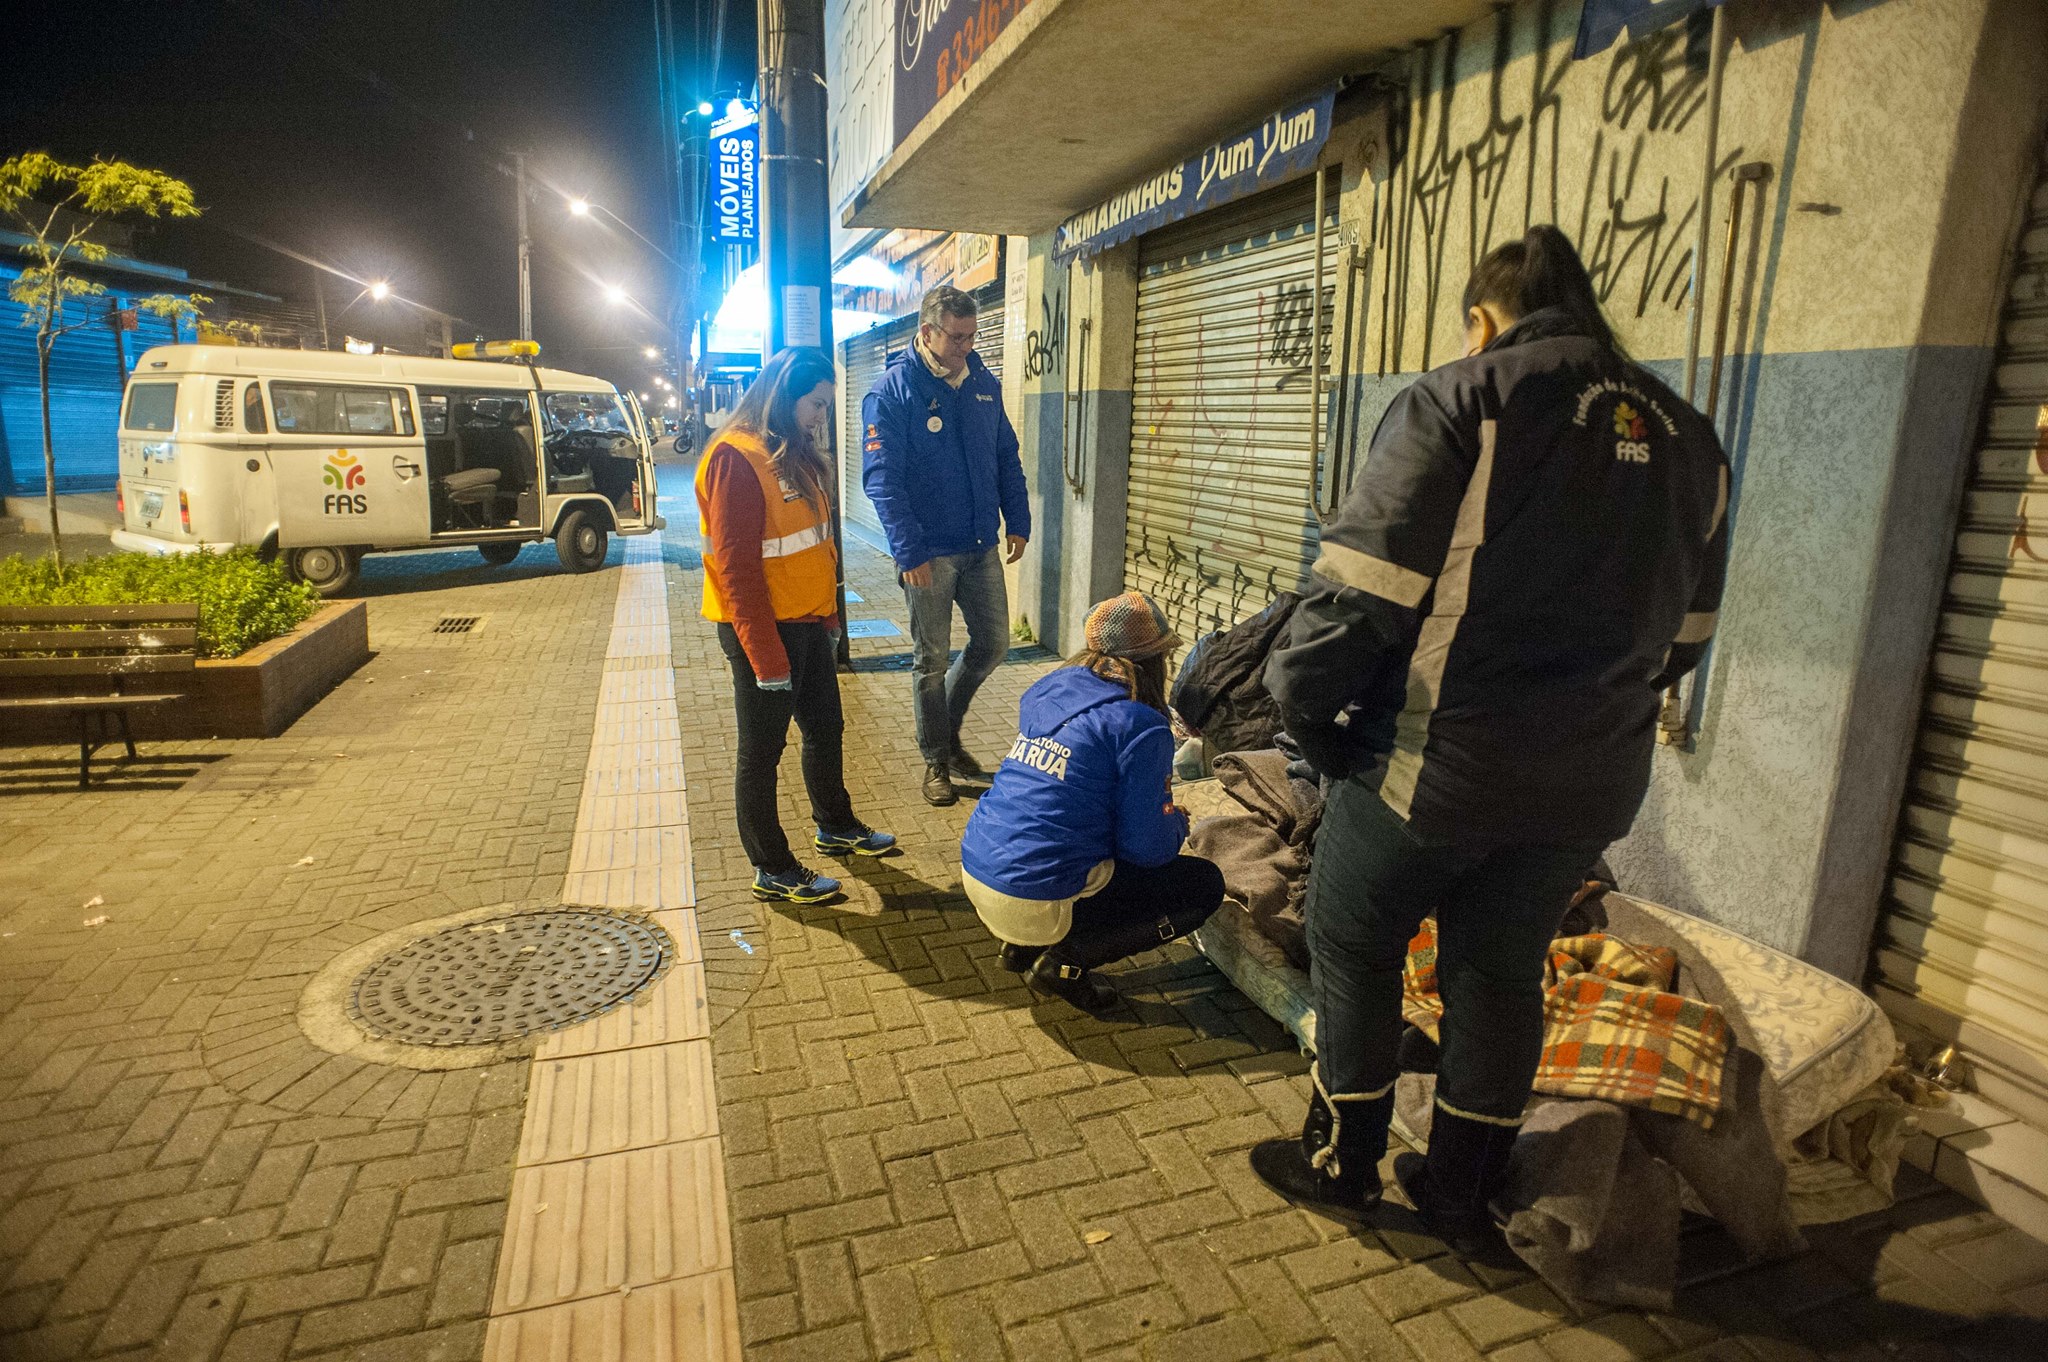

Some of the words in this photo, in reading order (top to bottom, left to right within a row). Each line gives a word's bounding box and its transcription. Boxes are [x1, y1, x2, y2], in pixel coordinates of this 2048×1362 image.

[714, 137, 741, 238] MÓVEIS
[741, 139, 754, 239] PLANEJADOS
[1061, 161, 1185, 252] ARMARINHOS
[1615, 440, 1650, 464] FAS
[323, 493, 368, 515] FAS
[1023, 744, 1068, 781] RUA
